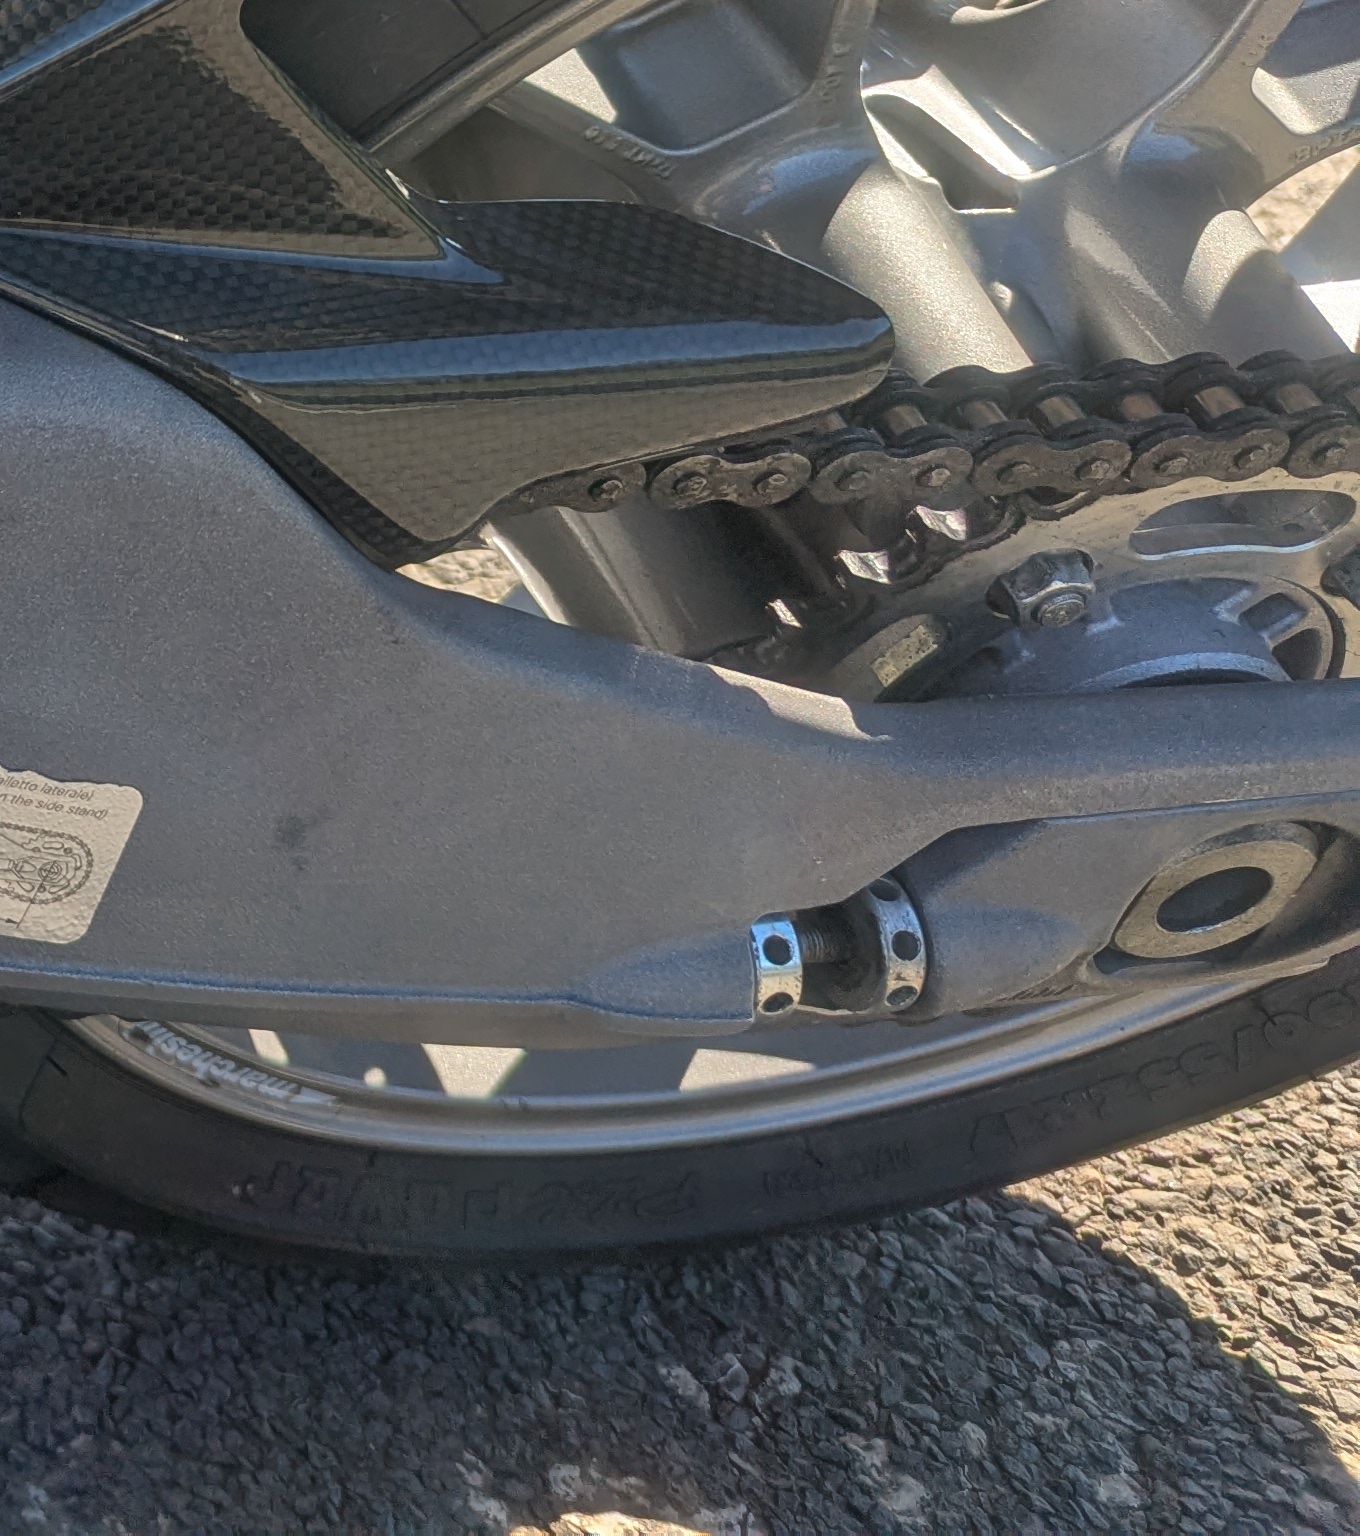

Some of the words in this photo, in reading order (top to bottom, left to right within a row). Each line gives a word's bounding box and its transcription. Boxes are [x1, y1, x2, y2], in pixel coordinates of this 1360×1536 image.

[40, 782, 96, 802] laterale)
[10, 794, 34, 807] the
[35, 798, 65, 813] side
[65, 804, 109, 821] stand)
